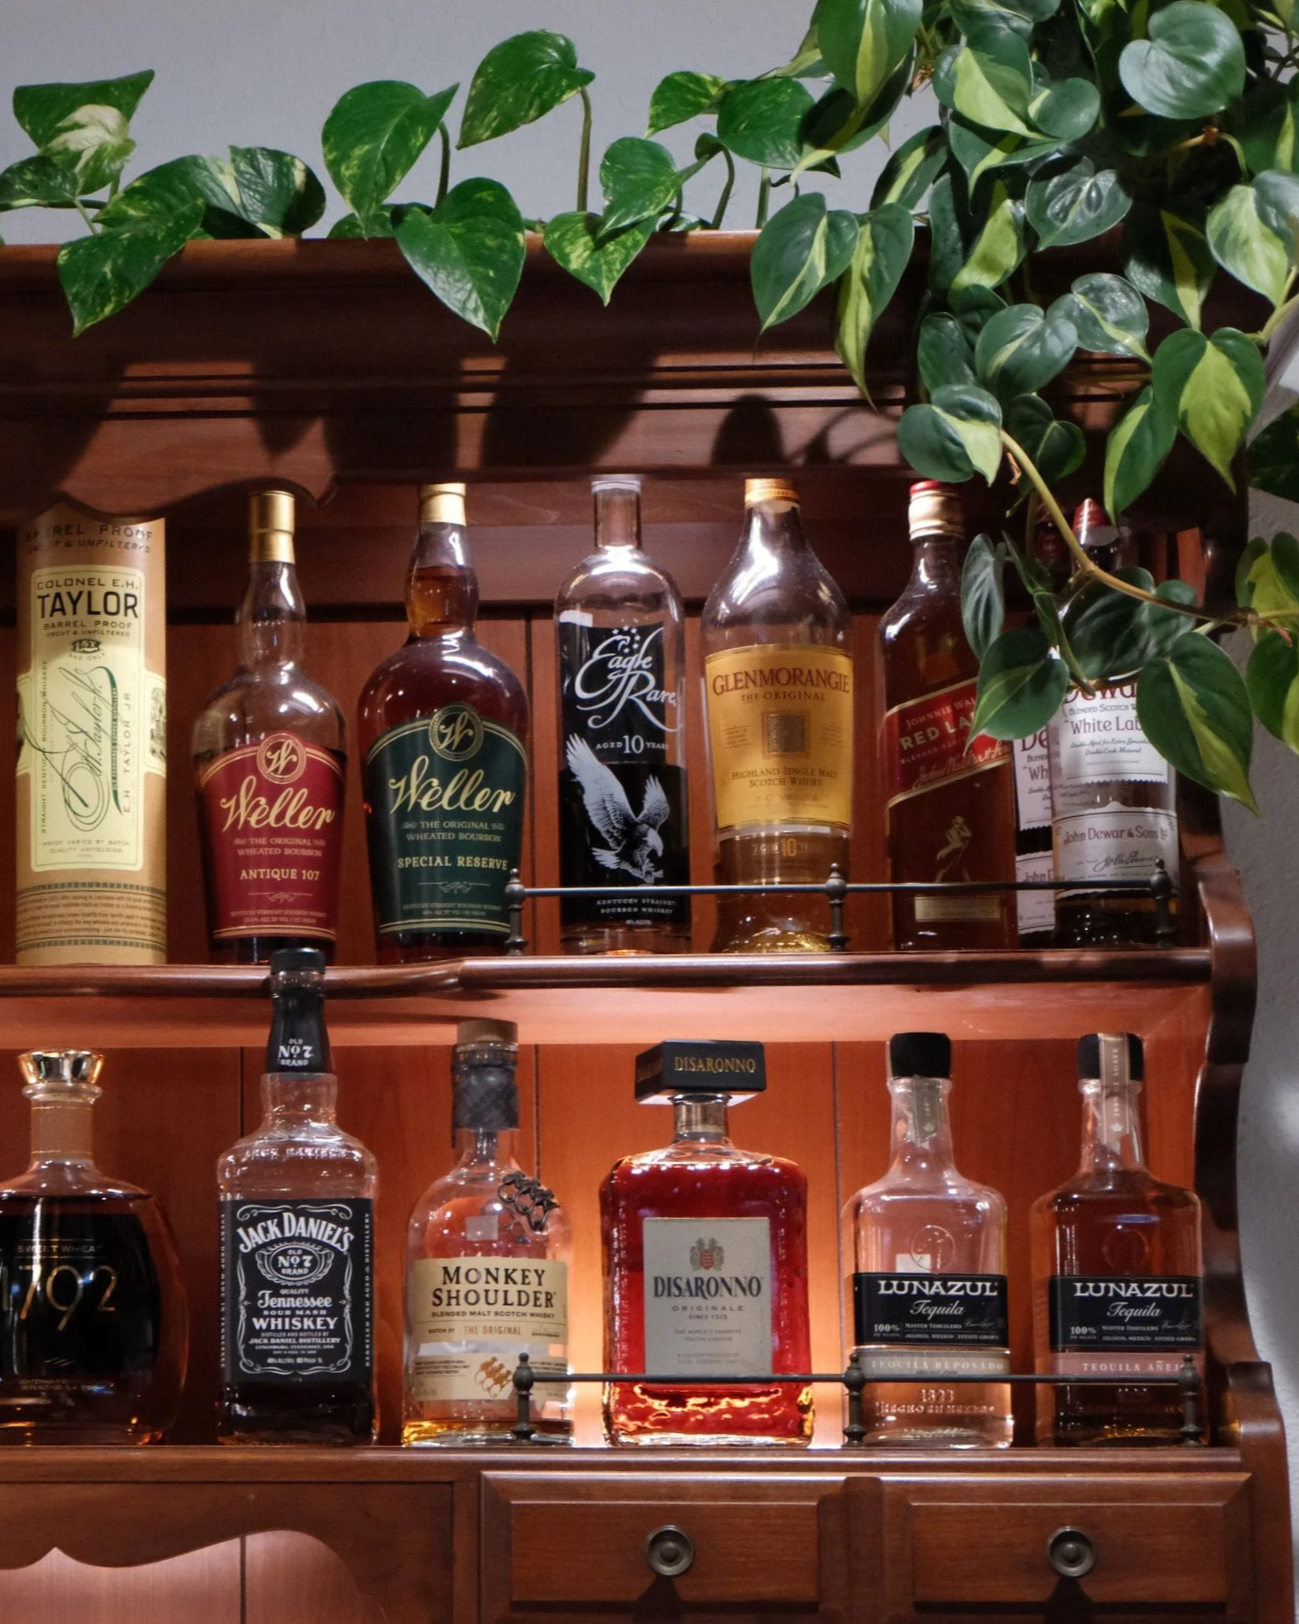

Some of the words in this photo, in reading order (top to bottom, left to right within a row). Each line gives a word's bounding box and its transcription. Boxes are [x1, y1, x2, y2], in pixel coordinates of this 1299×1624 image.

[36, 578, 105, 590] COLONEL
[112, 578, 138, 590] E.H.
[37, 590, 138, 618] TAYLOR
[43, 620, 86, 630] BARREL
[95, 620, 132, 629] PROOF
[712, 667, 850, 696] GLENMORANGIE
[588, 671, 682, 732] Rare
[742, 693, 759, 702] THE
[764, 691, 826, 702] ORIGINAL
[1100, 704, 1129, 713] SCOTCH
[906, 705, 952, 730] JOHNNIE
[900, 727, 940, 750] RED
[944, 712, 974, 733] LA
[623, 735, 644, 754] 10
[732, 768, 780, 780] HIGHLAND
[388, 755, 516, 814] Weller
[750, 777, 785, 788] SCOTCH
[790, 777, 822, 787] WHISKY
[220, 776, 335, 832] Weller
[420, 820, 440, 829] THE
[443, 820, 490, 830] ORIGINAL
[270, 838, 312, 846] ORIGINAL
[406, 832, 455, 842] WHEATED
[458, 832, 502, 842] BOURBON
[1064, 830, 1086, 846] John
[1088, 827, 1126, 840] Dewar
[1127, 828, 1134, 838] &
[1136, 826, 1158, 840] Sons
[237, 848, 280, 856] WHEATED
[284, 848, 322, 856] BOURBON
[781, 838, 797, 857] 10
[398, 856, 452, 868] SPECIAL
[457, 856, 508, 870] RESERVE
[240, 868, 298, 880] ANTIQUE
[302, 870, 320, 880] 107
[302, 1045, 314, 1058] 7
[674, 1056, 756, 1073] DISARONNO
[236, 1218, 282, 1253] JACK
[282, 1212, 355, 1252] DANIEL'S
[302, 1256, 314, 1268] 7
[442, 1266, 546, 1286] MONKEY
[654, 1276, 762, 1300] DISARONNO
[878, 1280, 998, 1296] LUNAZUL
[1074, 1282, 1194, 1298] LUNAZUL
[257, 1290, 332, 1308] Tennessee
[432, 1288, 554, 1308] SHOULDER
[910, 1300, 966, 1320] Tequila
[1106, 1302, 1162, 1322] Tequila
[252, 1318, 338, 1330] WHISKEY
[464, 1326, 478, 1335] THE
[482, 1326, 522, 1336] ORIGINAL
[874, 1324, 900, 1332] 100%
[1070, 1326, 1096, 1334] 100%
[872, 1360, 929, 1369] TEQUILA
[935, 1361, 1004, 1370] REPOSADO
[1082, 1362, 1140, 1372] TEQUILA
